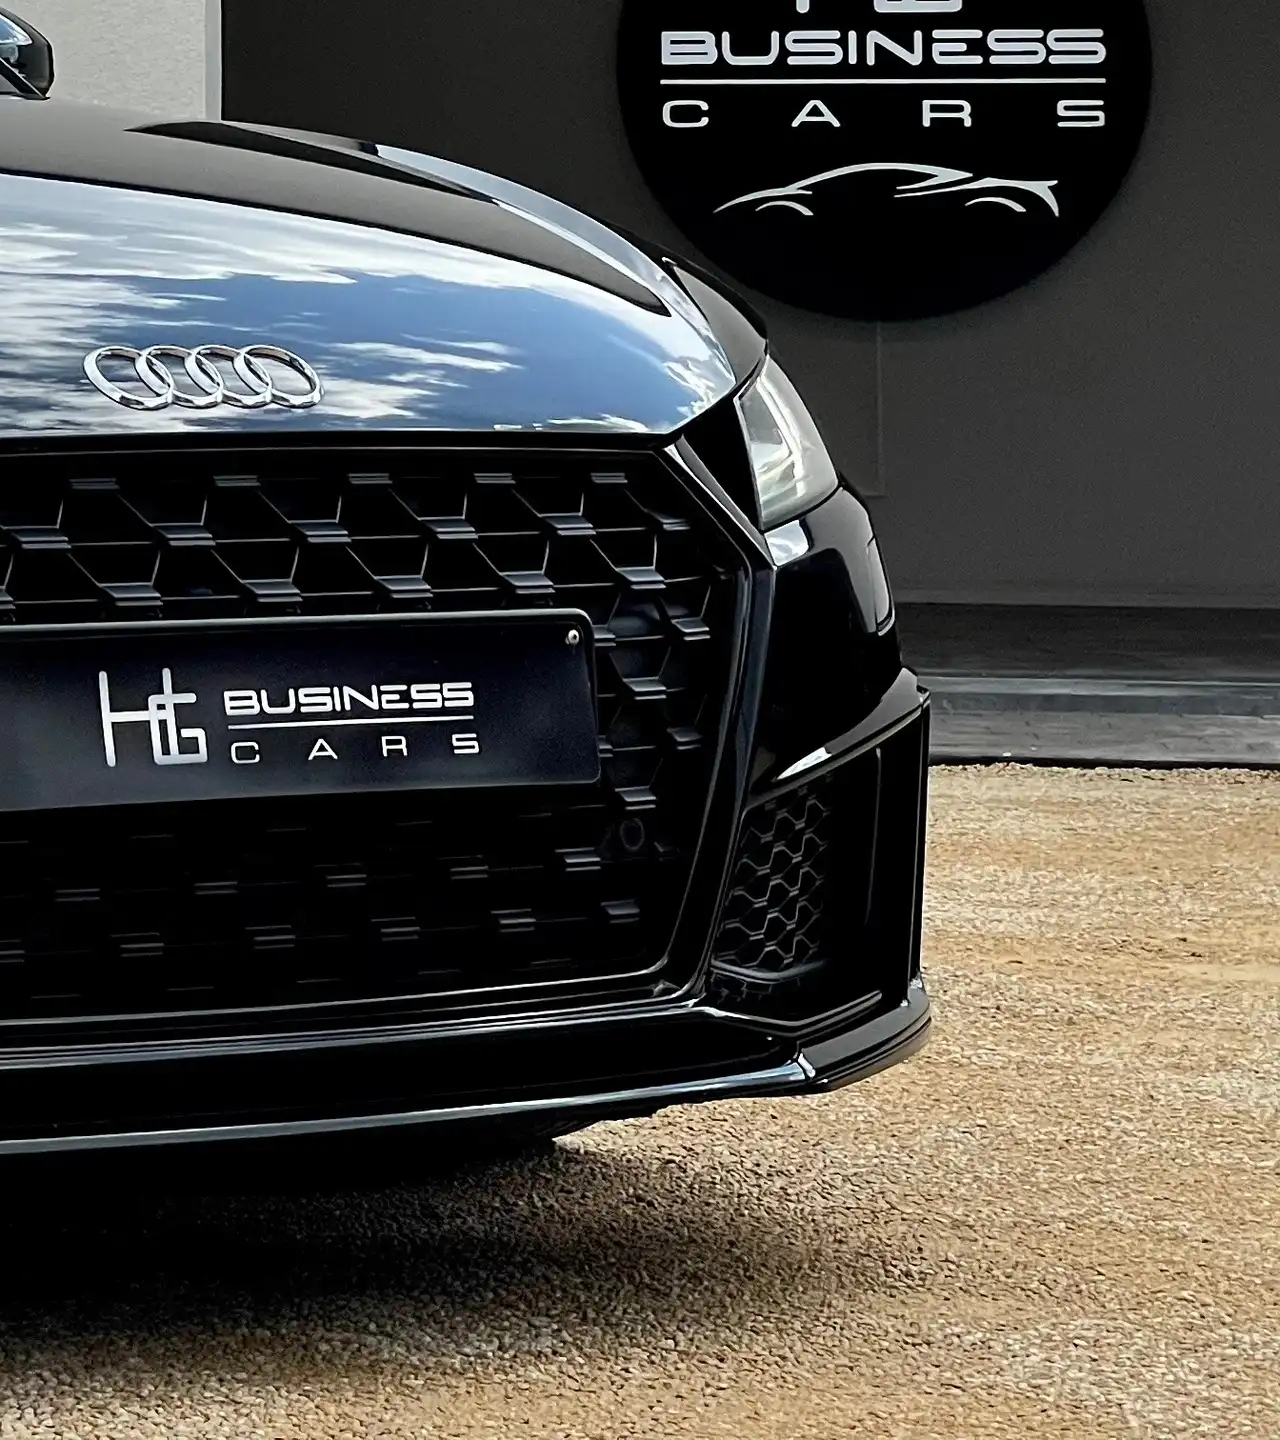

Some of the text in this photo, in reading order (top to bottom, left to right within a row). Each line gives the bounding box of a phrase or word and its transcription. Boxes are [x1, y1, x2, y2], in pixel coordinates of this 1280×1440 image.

[661, 29, 1106, 65] BUSINESS
[662, 99, 1105, 127] CARS
[224, 682, 475, 716] BUSINESS
[231, 733, 480, 764] CARS
